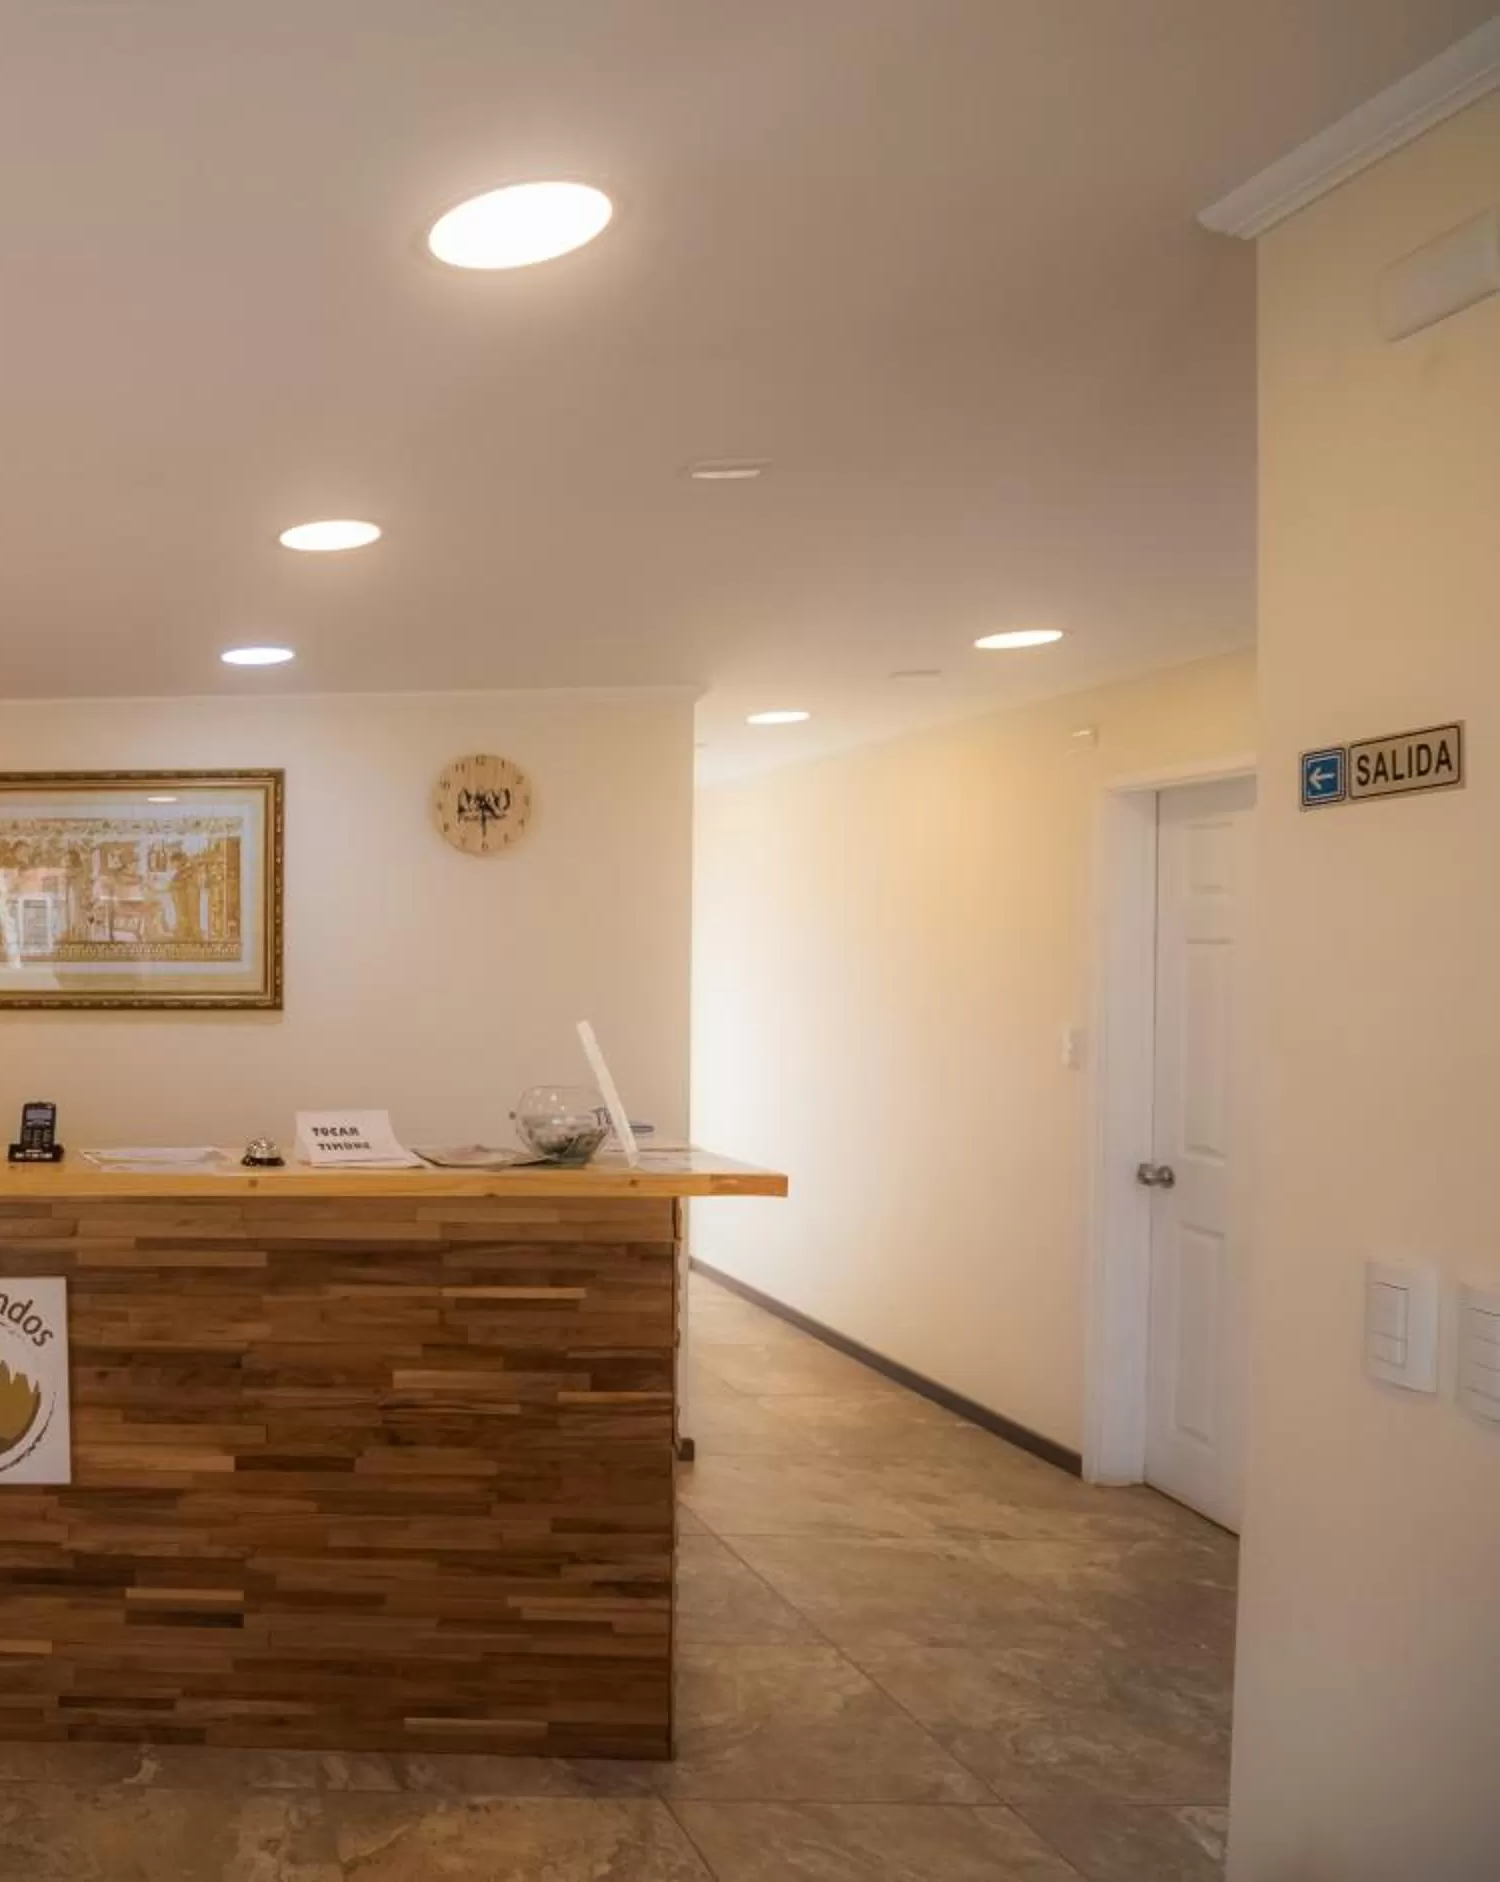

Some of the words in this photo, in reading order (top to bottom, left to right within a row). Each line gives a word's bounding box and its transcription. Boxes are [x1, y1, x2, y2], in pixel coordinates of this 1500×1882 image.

[1356, 739, 1453, 787] SALIDA
[311, 1127, 361, 1137] TOCAR
[317, 1141, 371, 1152] TIMBRE
